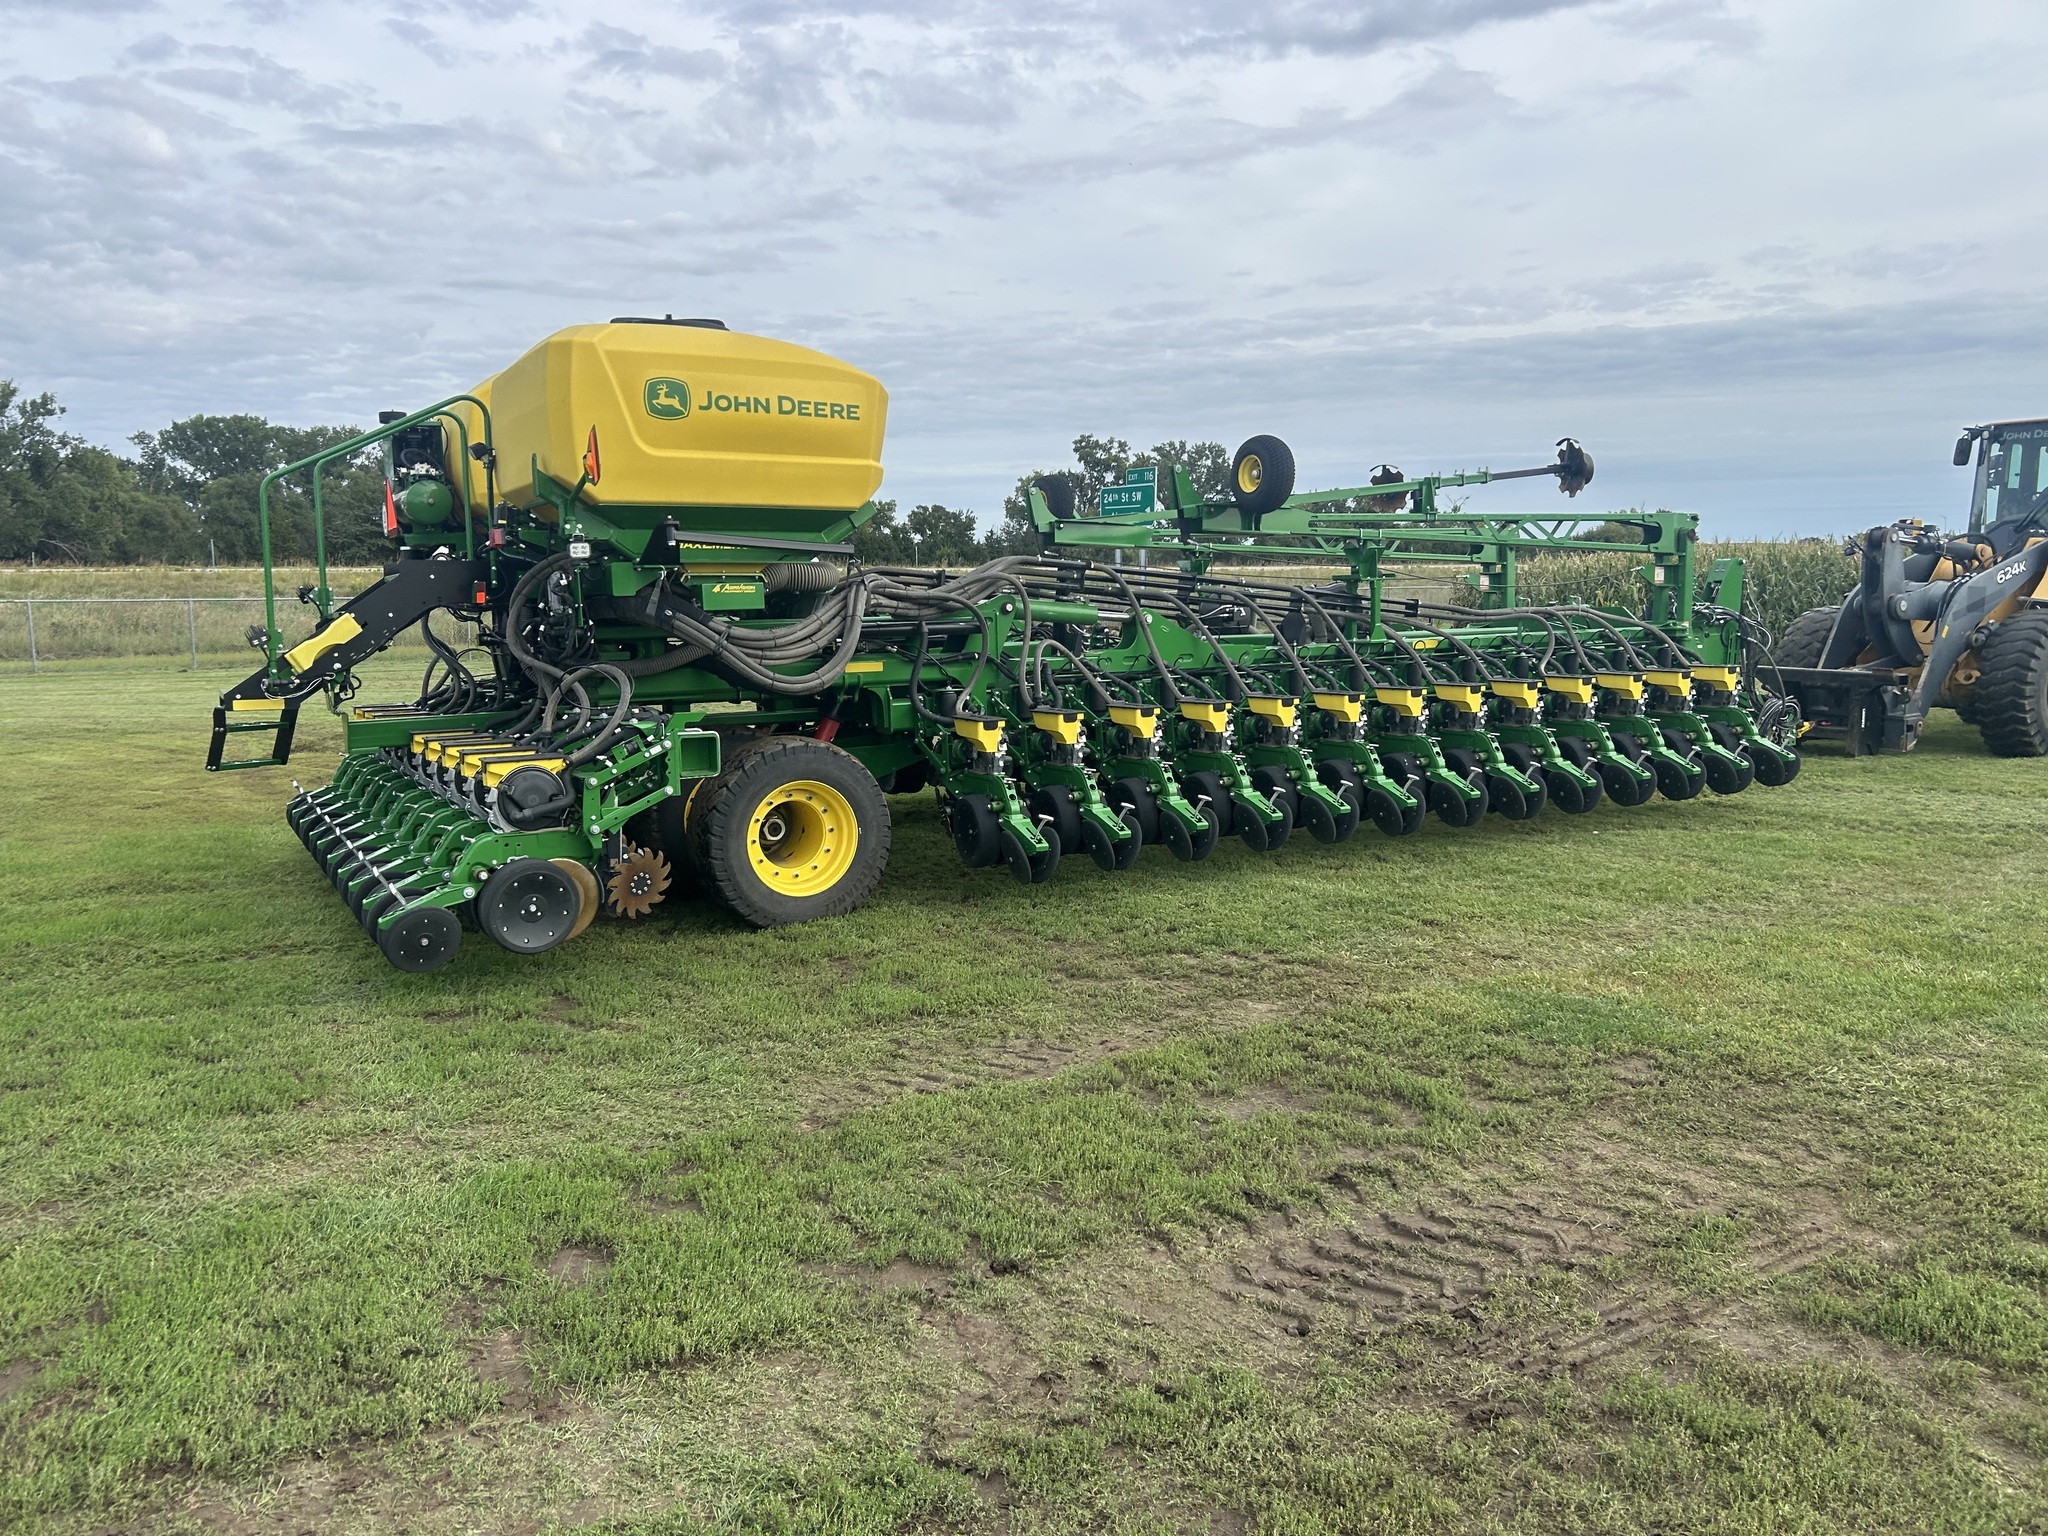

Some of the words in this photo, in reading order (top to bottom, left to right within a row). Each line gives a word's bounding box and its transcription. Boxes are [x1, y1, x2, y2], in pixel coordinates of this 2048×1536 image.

[698, 391, 771, 414] JOHN
[777, 395, 861, 421] DEERE
[1999, 430, 2032, 441] JOHN
[1128, 473, 1138, 481] EXIT
[1103, 493, 1119, 503] 24th
[1121, 492, 1129, 503] St
[1131, 491, 1142, 502] SW
[1996, 560, 2027, 584] 624K
